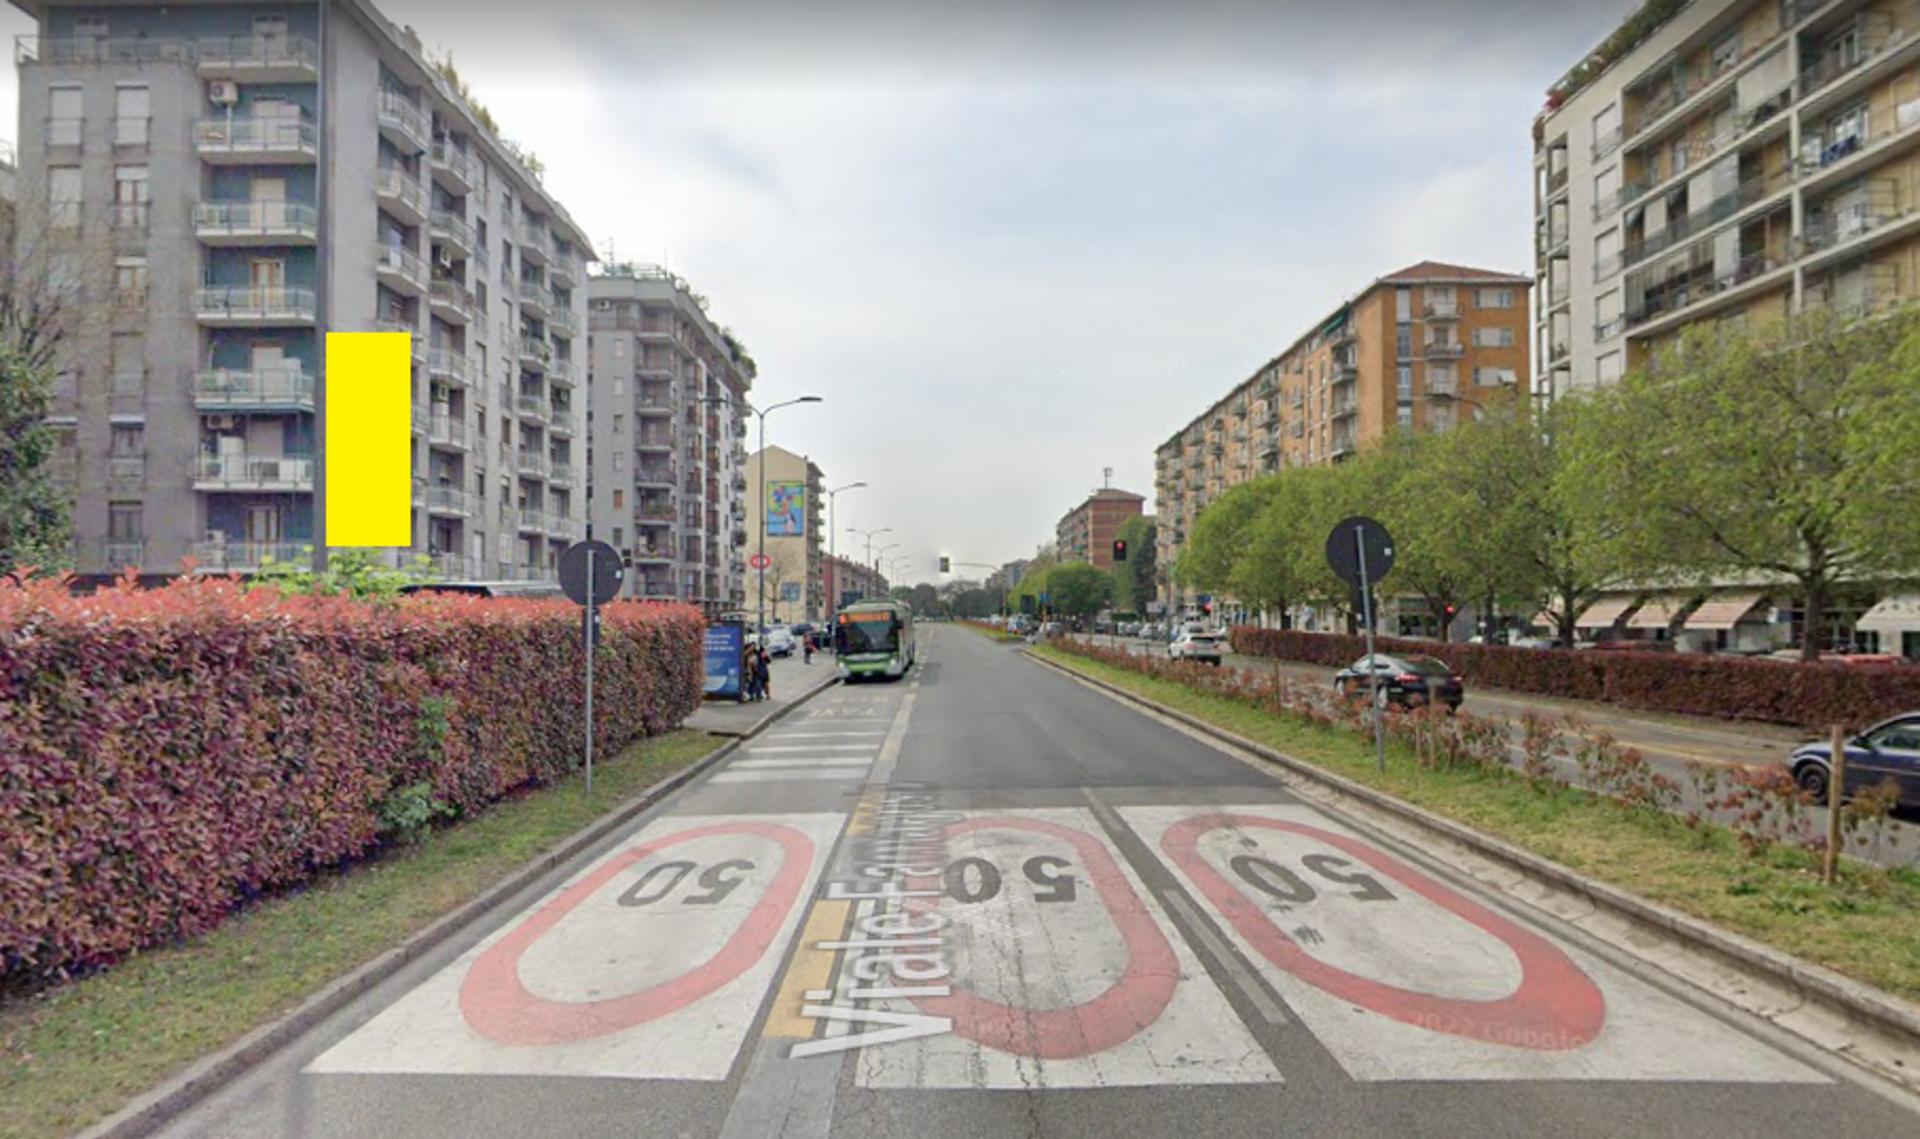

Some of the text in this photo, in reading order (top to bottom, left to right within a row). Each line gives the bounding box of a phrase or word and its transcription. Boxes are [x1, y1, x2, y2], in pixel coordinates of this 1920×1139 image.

[617, 859, 755, 906] 50
[944, 855, 1076, 903] 50
[1230, 855, 1398, 902] 50
